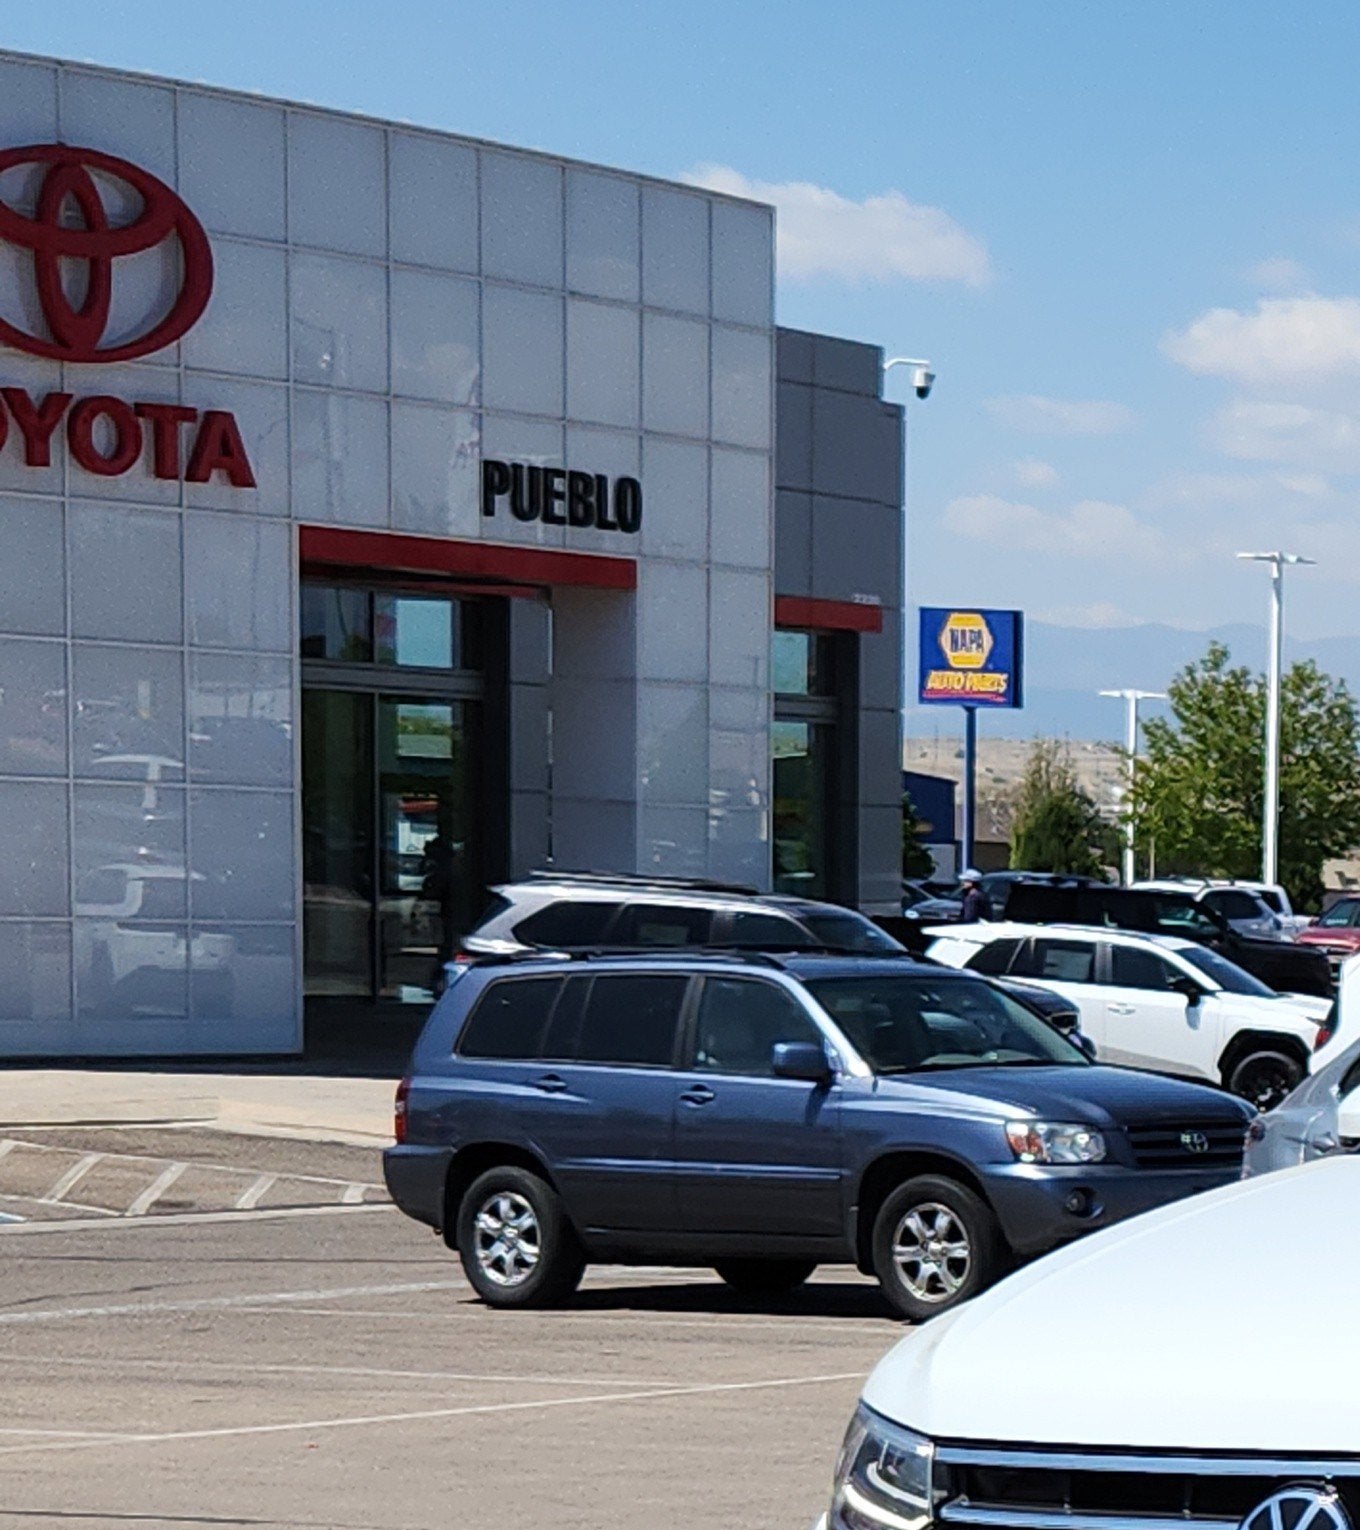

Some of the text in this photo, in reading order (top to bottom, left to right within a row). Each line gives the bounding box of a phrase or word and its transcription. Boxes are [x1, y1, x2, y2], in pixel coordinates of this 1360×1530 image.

[0, 386, 257, 488] YOTA
[482, 459, 643, 534] PUEBLO
[949, 628, 984, 653] NAPA
[926, 670, 965, 690] AUTO
